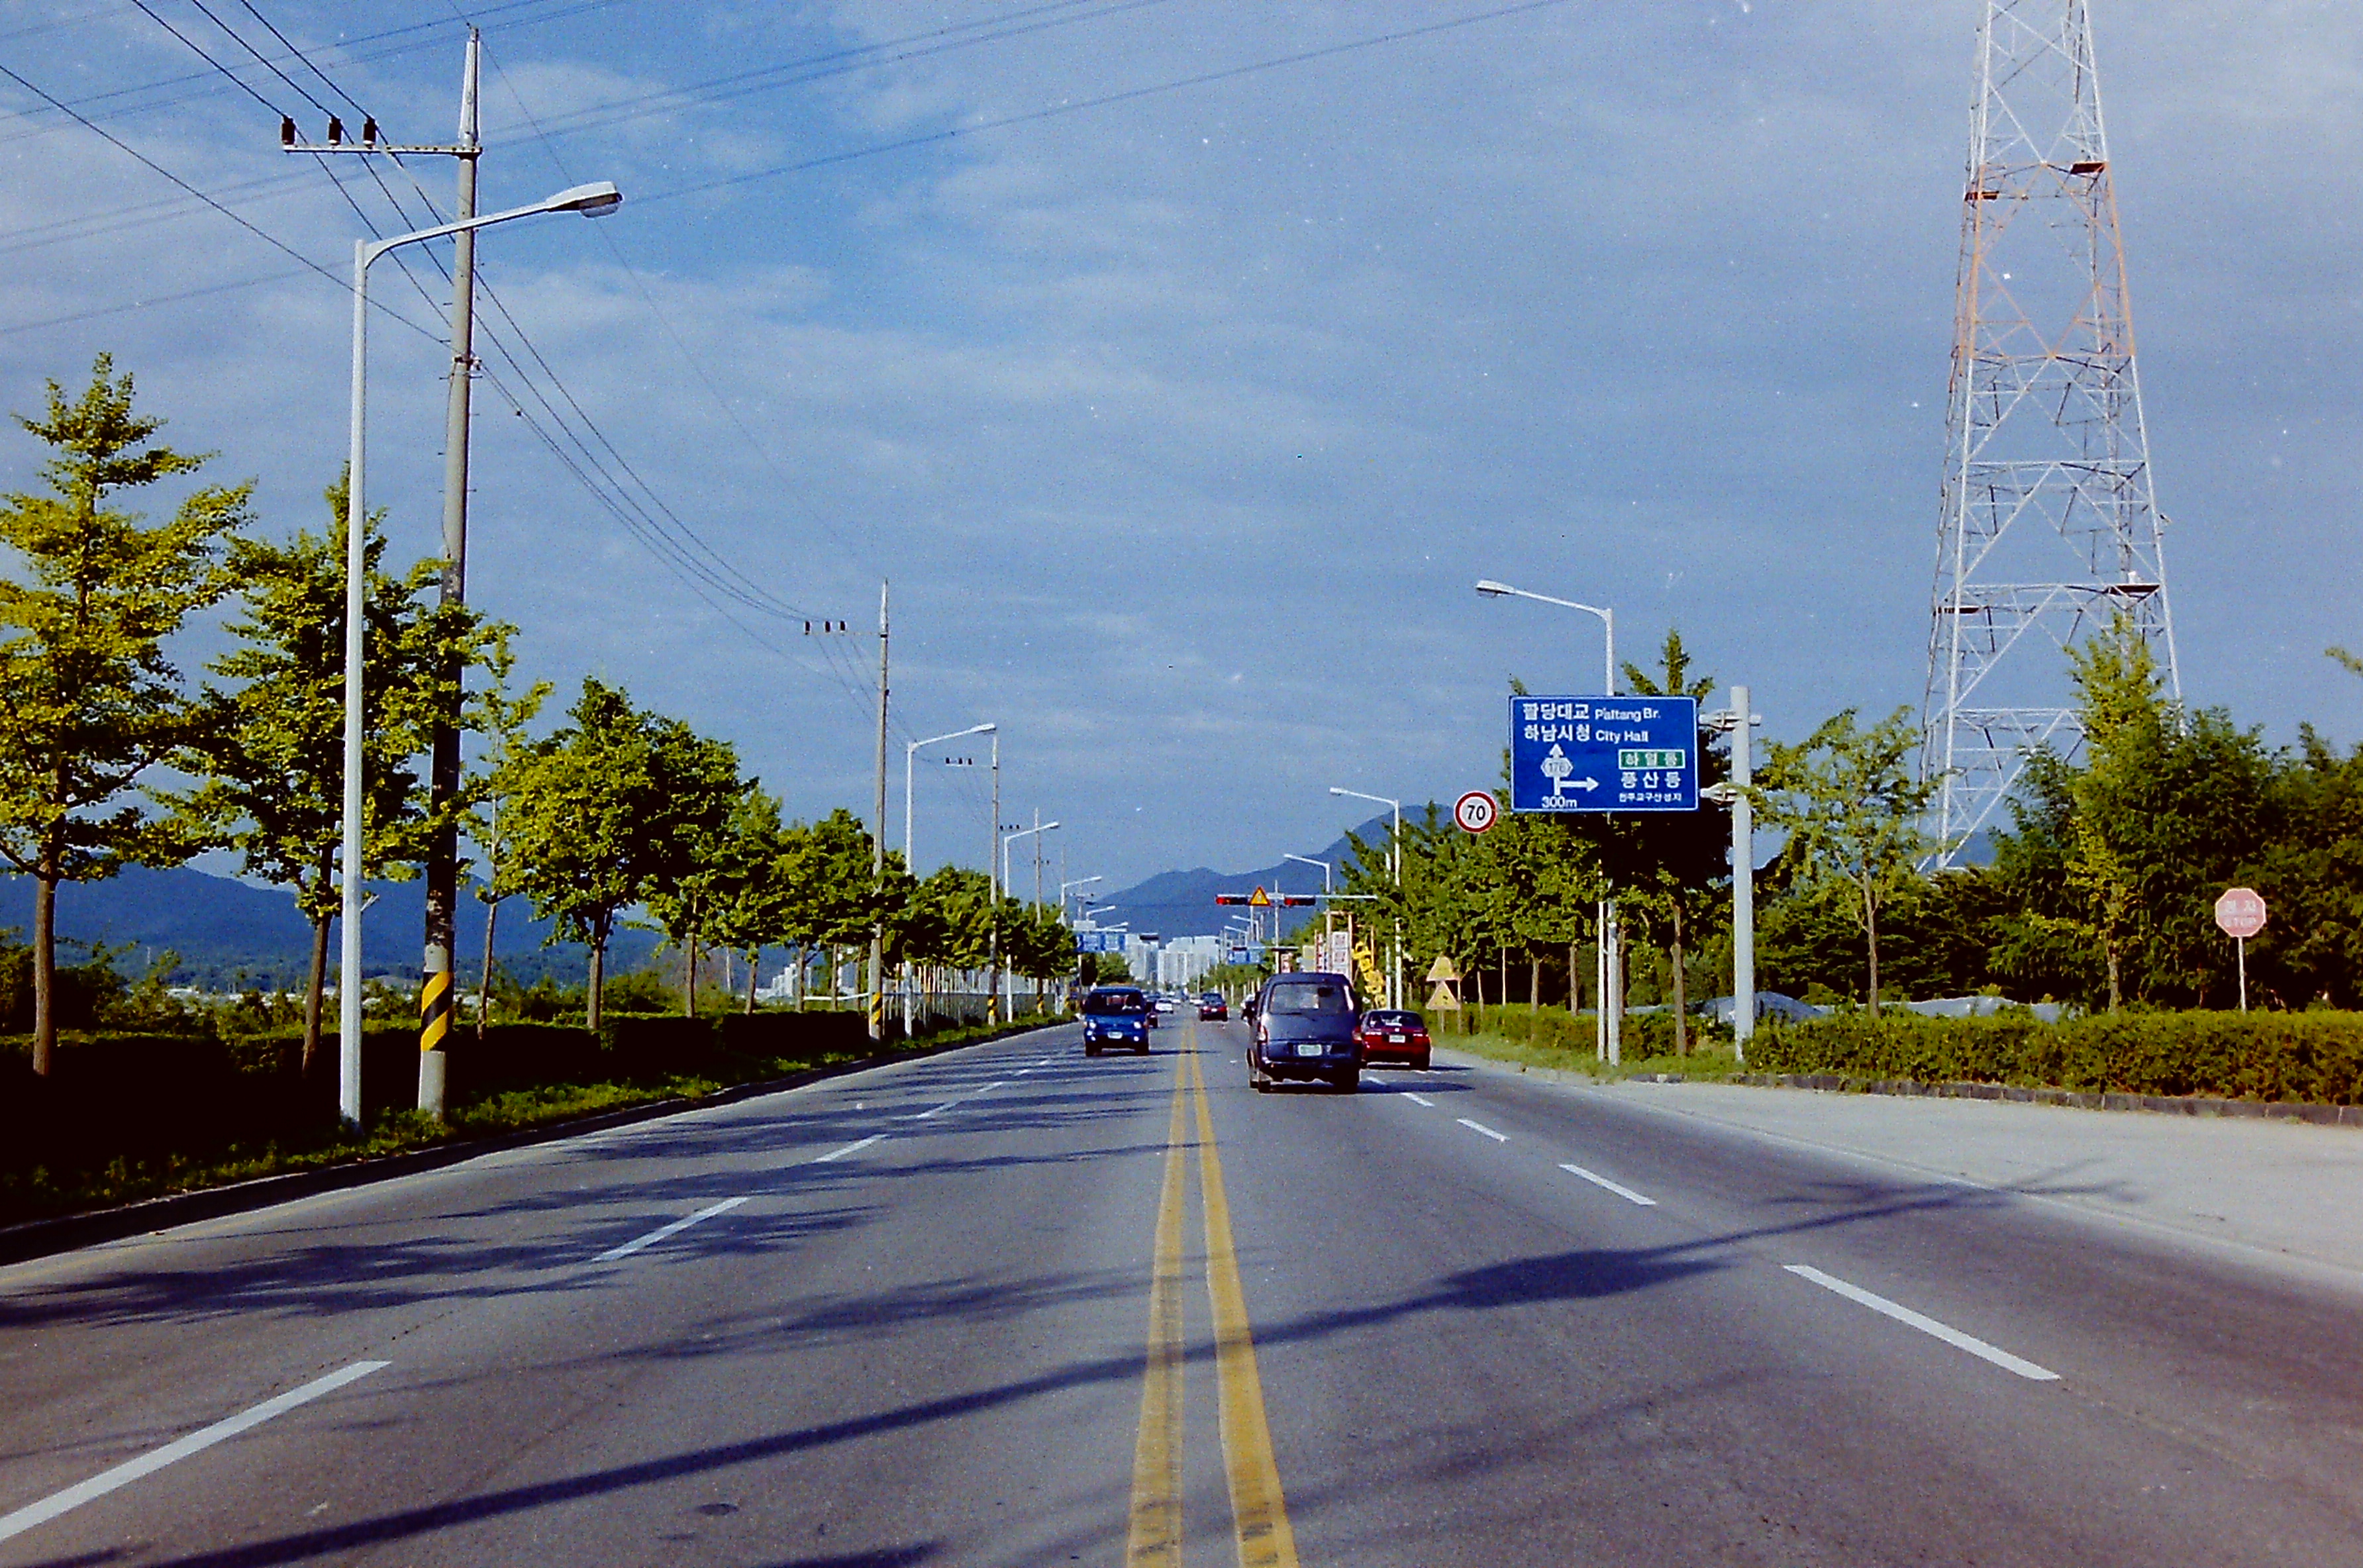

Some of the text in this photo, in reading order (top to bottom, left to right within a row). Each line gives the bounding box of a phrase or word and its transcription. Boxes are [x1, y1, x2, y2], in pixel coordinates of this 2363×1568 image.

[1523, 703, 1589, 720] 팔당대교
[1524, 724, 1589, 742] 하남시청
[1595, 729, 1648, 744] City Hall
[1541, 795, 1578, 808] 300m
[1468, 805, 1486, 821] 70
